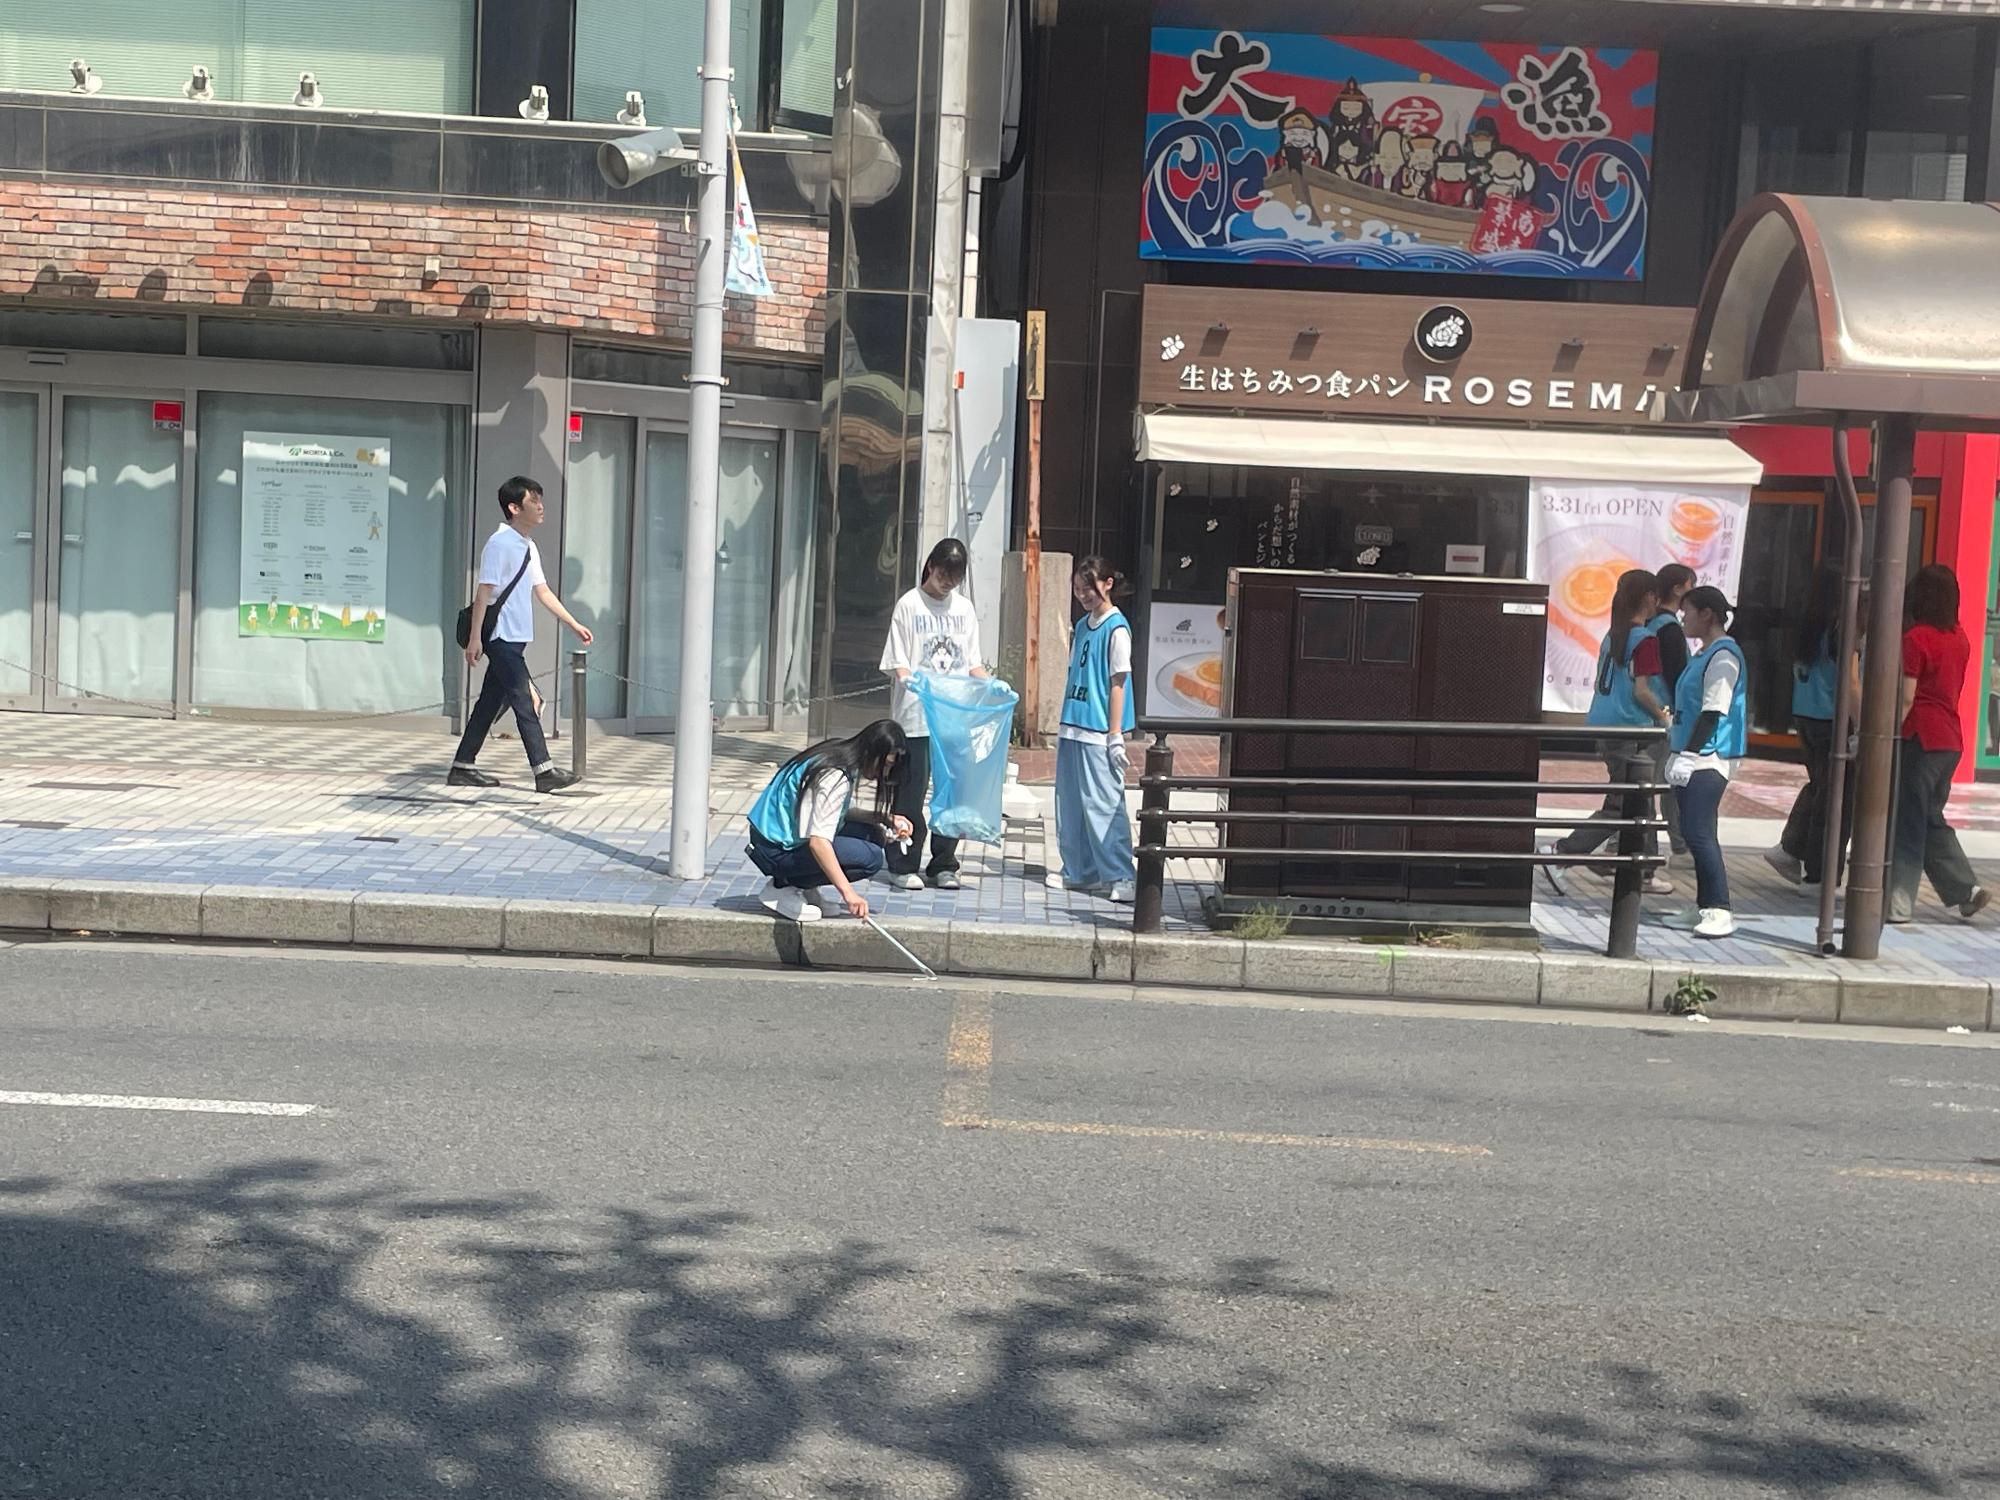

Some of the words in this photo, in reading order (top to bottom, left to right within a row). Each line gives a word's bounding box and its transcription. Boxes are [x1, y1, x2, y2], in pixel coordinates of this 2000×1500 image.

[1179, 31, 1295, 128] 大
[1502, 48, 1610, 138] 漁
[1179, 363, 1411, 400] 生はちみつ食パン
[1423, 374, 1681, 413] ROSEMA
[1606, 497, 1664, 517] OPEN
[1256, 521, 1268, 568] パンとジ
[1080, 639, 1090, 668] 8
